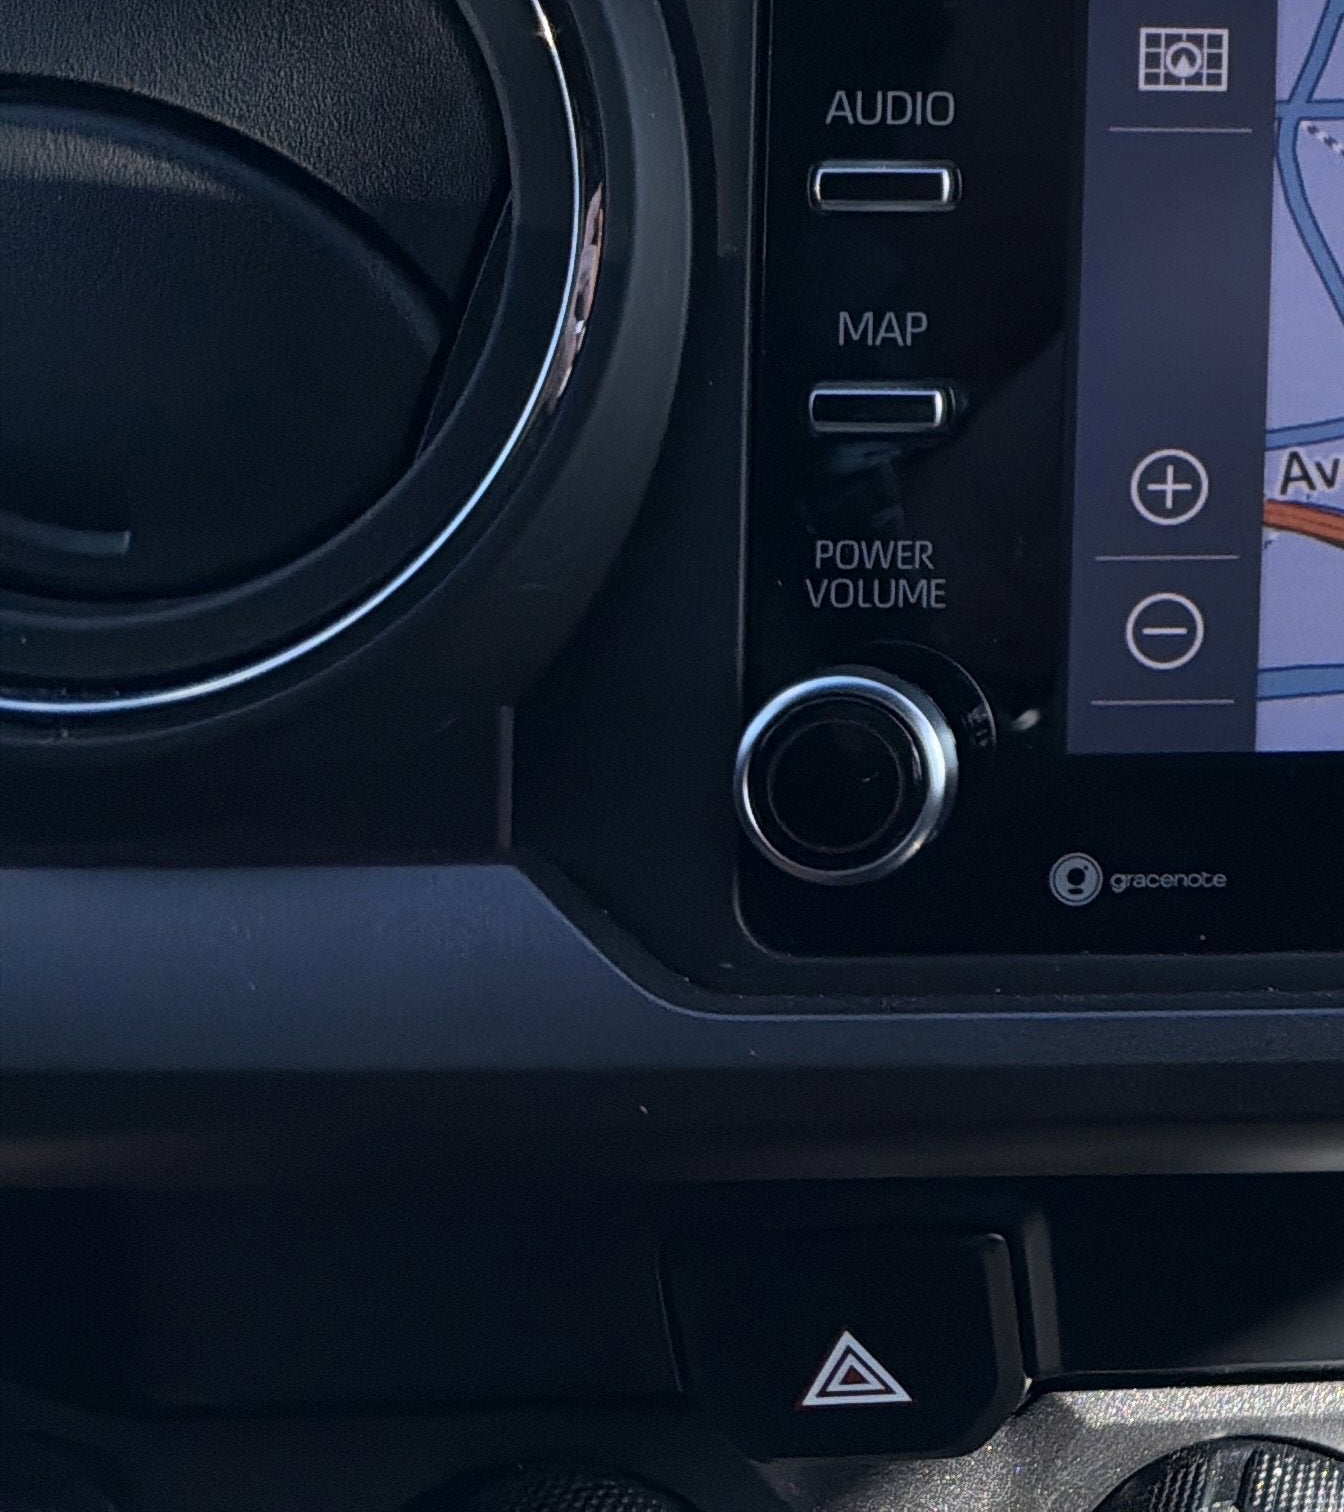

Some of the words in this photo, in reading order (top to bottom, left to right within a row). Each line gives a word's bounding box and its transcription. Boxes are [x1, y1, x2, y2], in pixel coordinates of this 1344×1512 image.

[825, 90, 955, 126] AUDIO
[838, 311, 928, 346] MAP
[814, 539, 935, 570] POWER
[806, 577, 947, 609] VOLUME
[1109, 871, 1229, 894] gracenote
